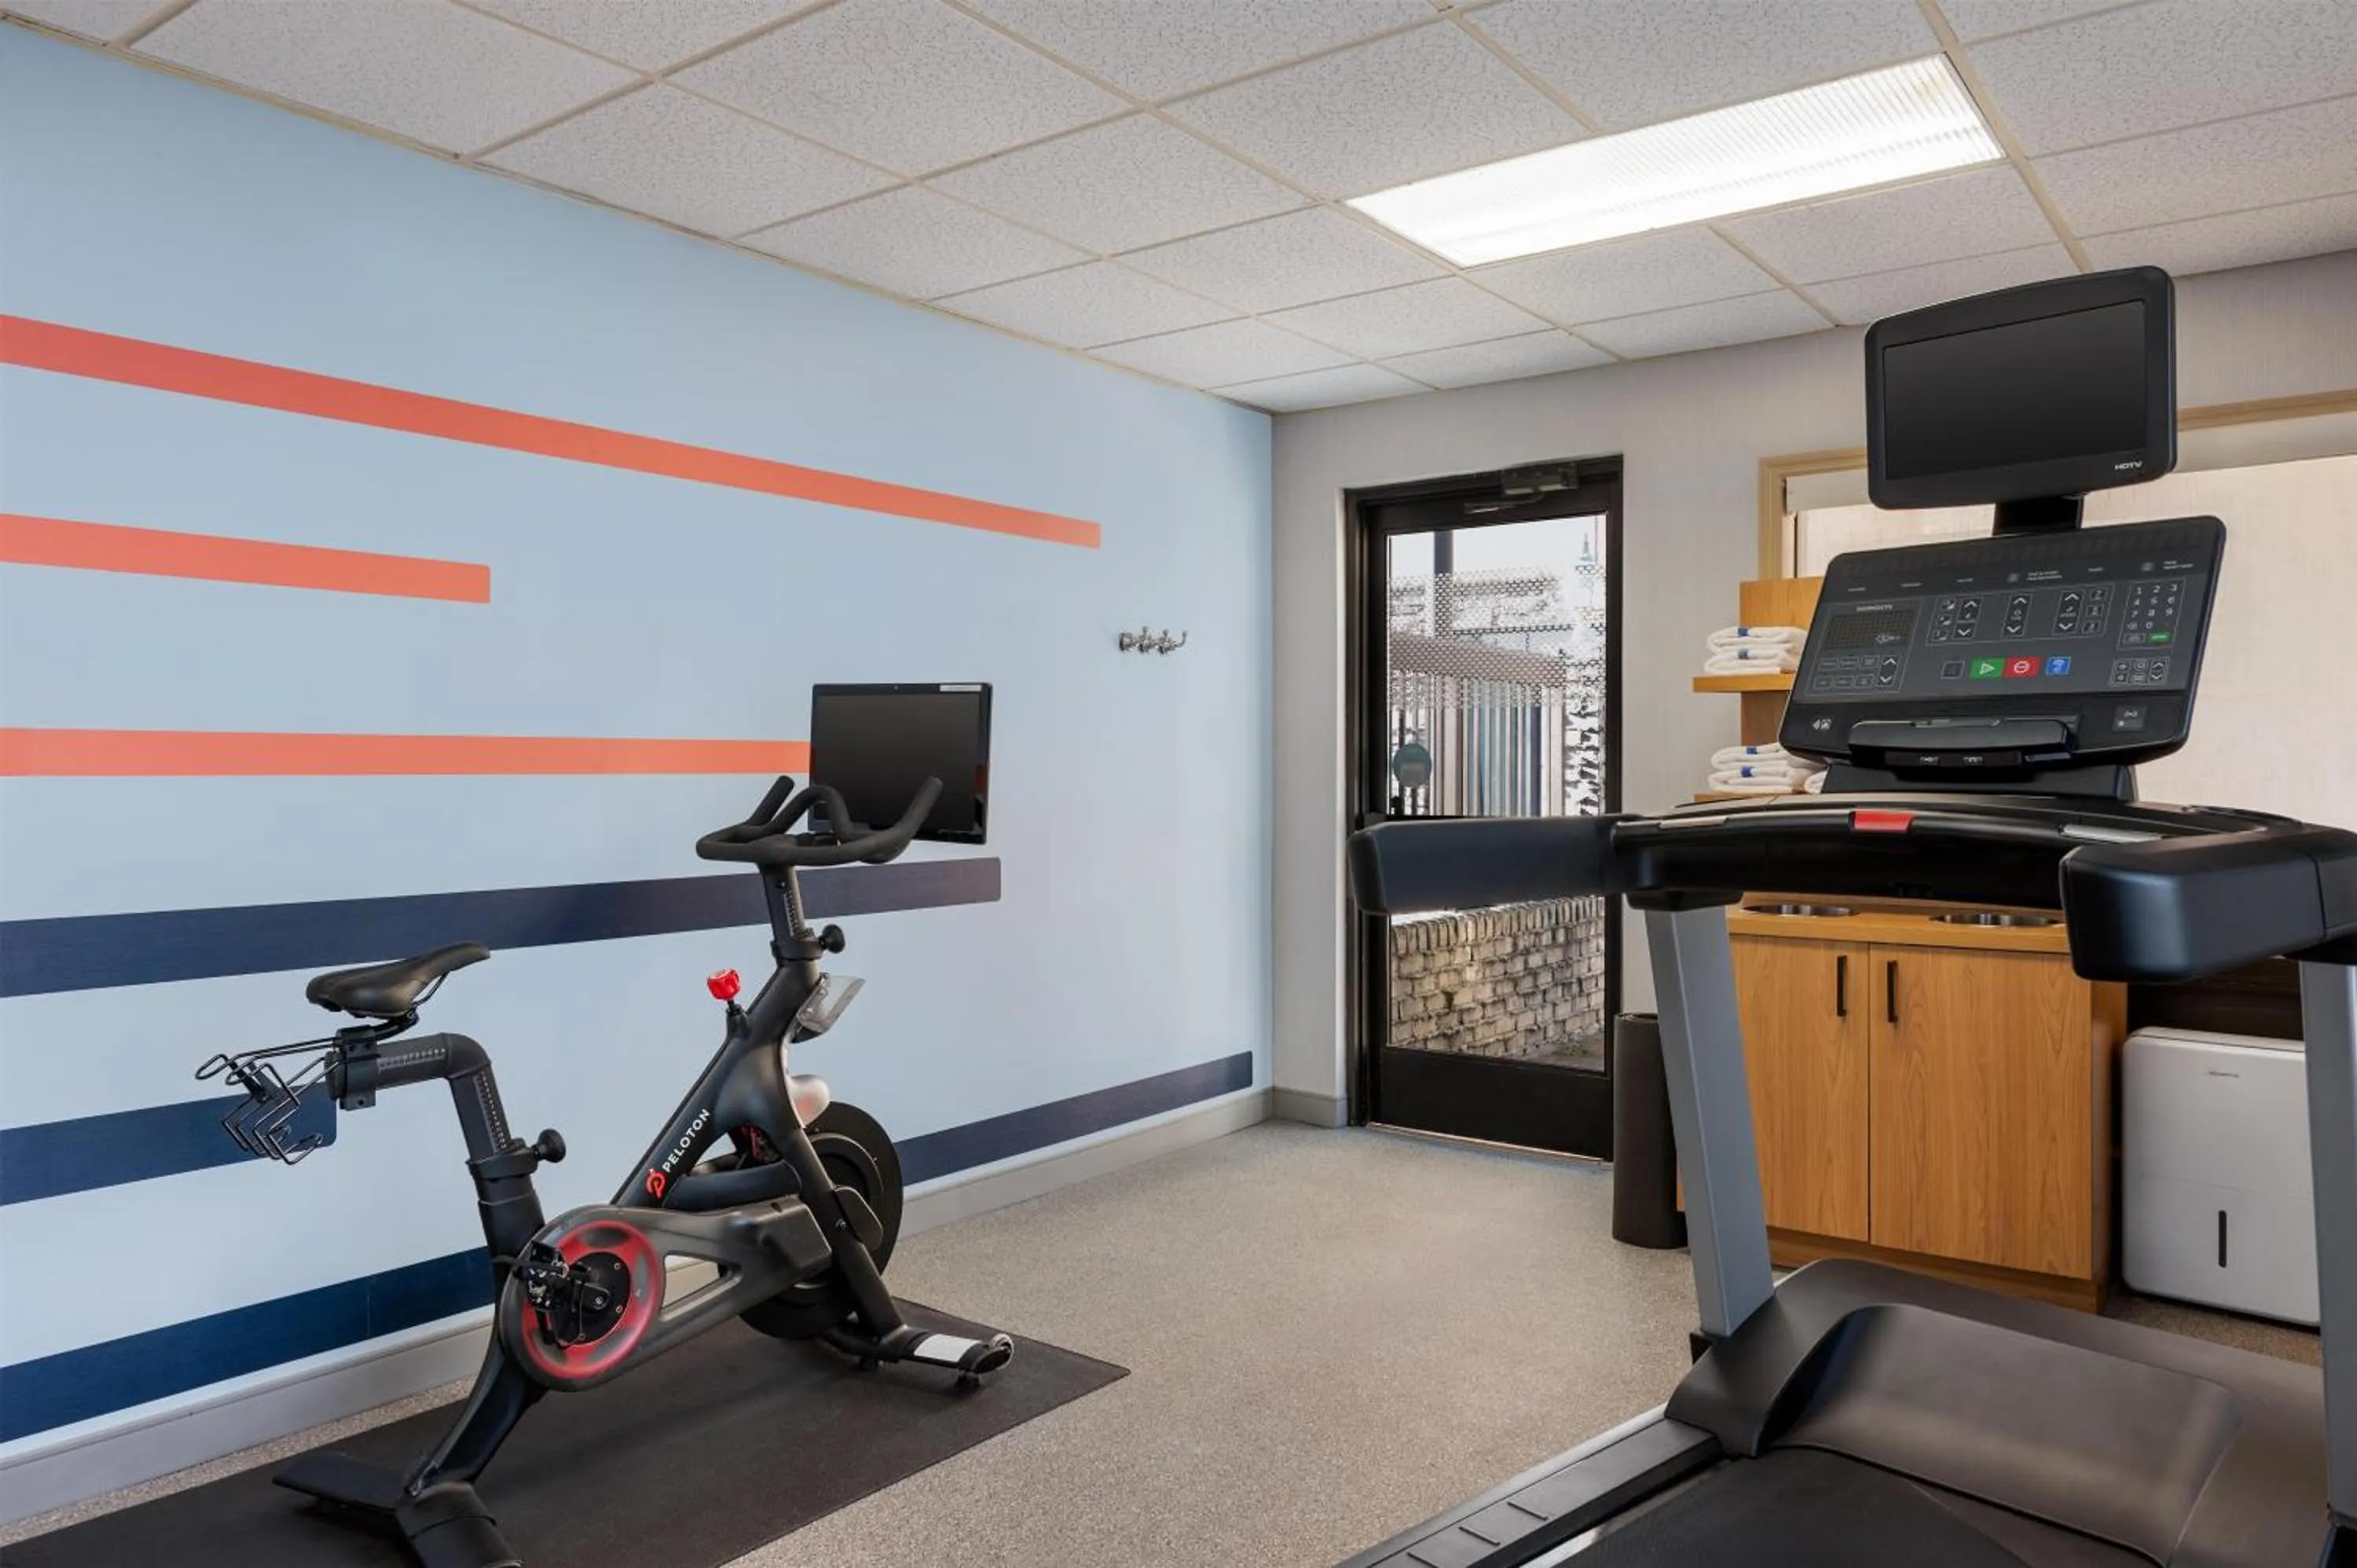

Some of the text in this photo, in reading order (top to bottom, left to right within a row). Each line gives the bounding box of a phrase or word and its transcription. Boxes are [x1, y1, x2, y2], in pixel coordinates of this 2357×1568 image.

[2113, 460, 2143, 471] HDTV
[2153, 584, 2161, 593] 2
[2131, 610, 2139, 618] 7
[2145, 621, 2154, 629] 0
[662, 1108, 710, 1173] PELOTON
